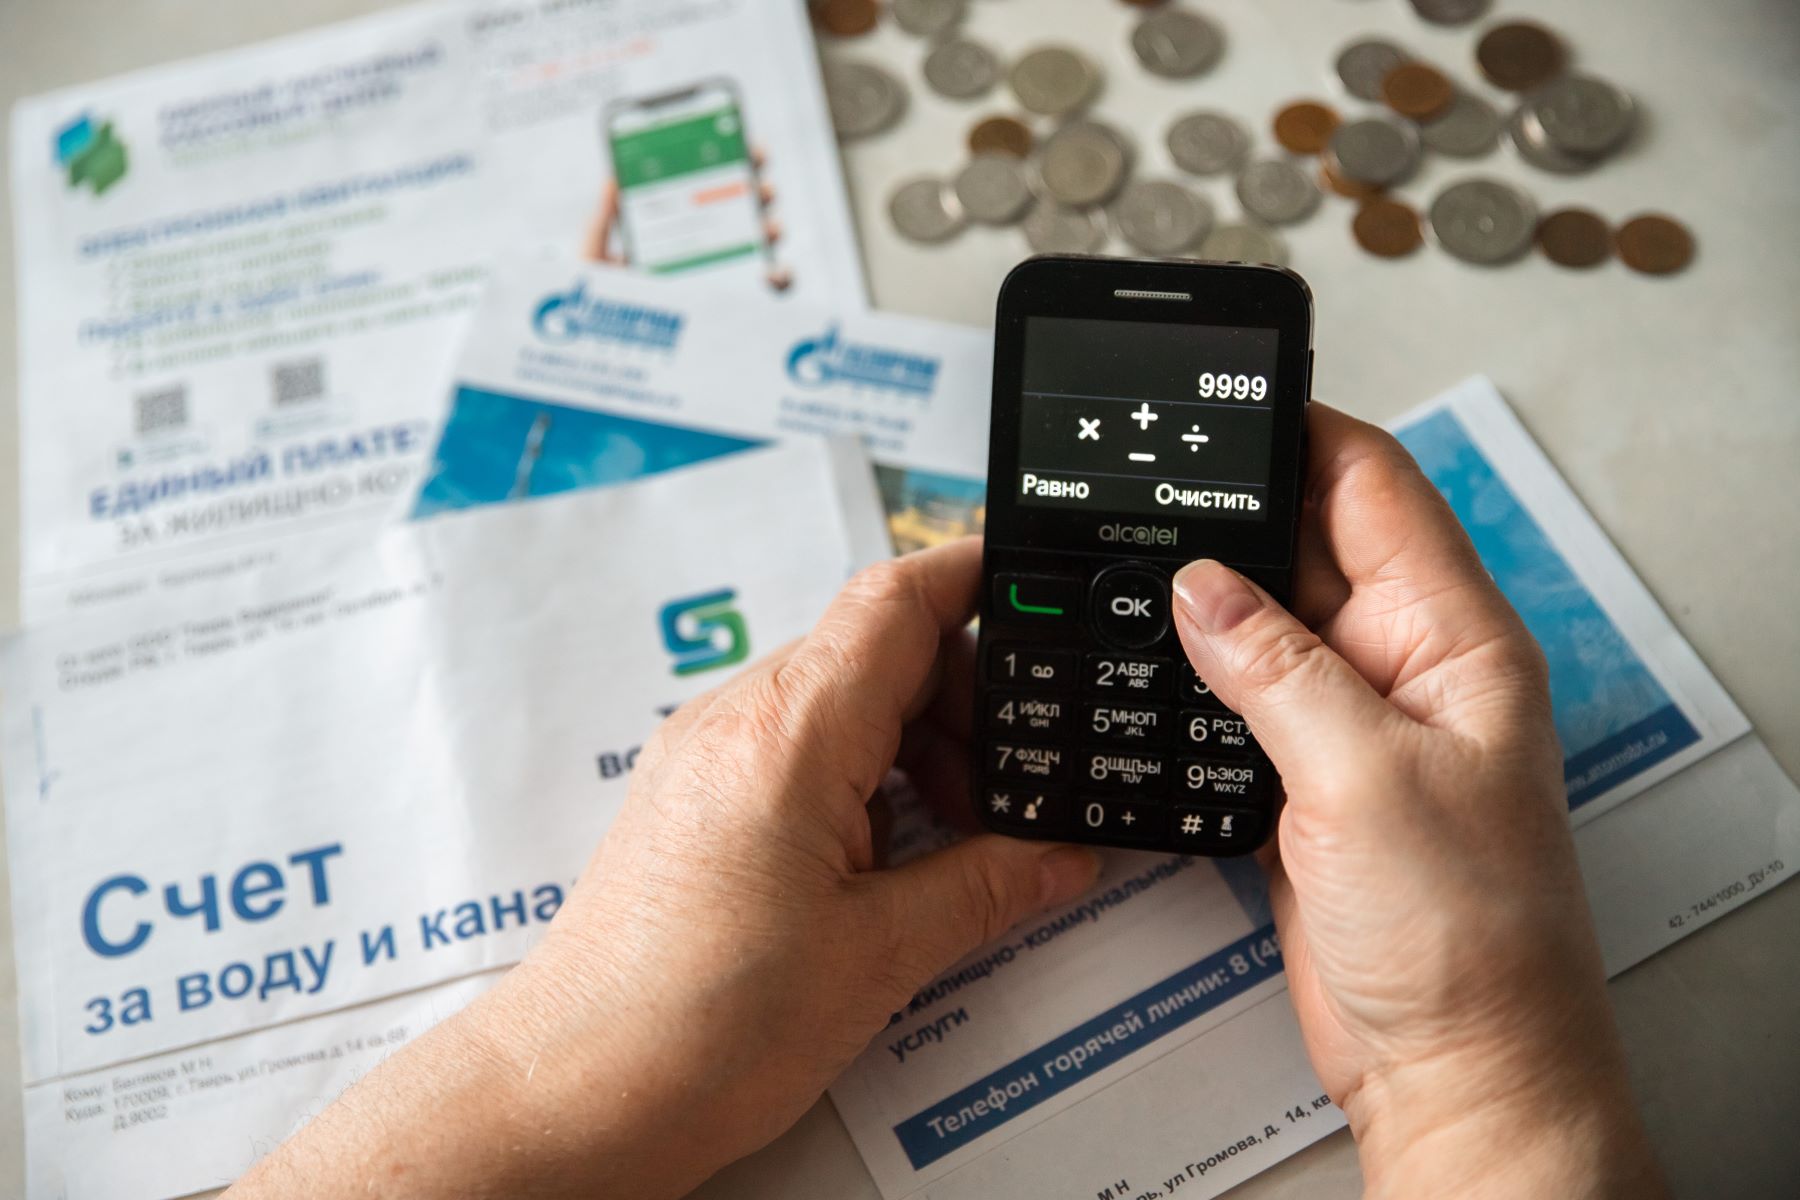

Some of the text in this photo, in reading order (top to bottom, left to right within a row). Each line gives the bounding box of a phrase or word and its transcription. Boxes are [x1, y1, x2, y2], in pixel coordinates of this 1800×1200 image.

[1199, 373, 1267, 400] 9999
[88, 451, 272, 520] ЕДИНЫЙ
[282, 421, 430, 475] ПЛАТЕ
[1022, 474, 1090, 499] Равно
[1155, 483, 1260, 511] Очистить
[1099, 524, 1178, 546] alcatel
[1111, 597, 1152, 617] OK
[1005, 653, 1016, 677] 1
[1096, 661, 1159, 686] 2 АБВГ
[1128, 679, 1149, 689] ABC
[997, 701, 1060, 725] 4 ИЙКЛ
[1029, 718, 1050, 729] GHI
[1092, 708, 1157, 733] 5 МНОП
[1124, 726, 1145, 737] JKL
[1189, 717, 1208, 741] 6
[1221, 735, 1245, 746] MNO
[996, 746, 1061, 770] 7 ФХЦЧ
[1090, 756, 1161, 780] 8 ШЩЪЫ
[1121, 773, 1143, 784] TUV
[1187, 765, 1254, 789] 9 ЬЭЮЯ
[1213, 782, 1246, 794] WXYZ
[1086, 803, 1104, 827] 0
[80, 842, 343, 959] Счет
[908, 853, 1195, 1013] жилищно-коммунальные
[1668, 914, 1685, 929] 42
[83, 880, 566, 1036] за воду и кана
[888, 1007, 970, 1064] услуги
[926, 1072, 1041, 1139] Телефон
[1042, 1008, 1146, 1080] горячей
[1146, 967, 1231, 1025] линии:
[1229, 953, 1250, 976] 8
[1163, 1173, 1186, 1194] ул
[1185, 1132, 1263, 1177] Громова,
[1264, 1123, 1281, 1139] д.
[1285, 1104, 1311, 1123] 14,
[1114, 1179, 1130, 1195] Н
